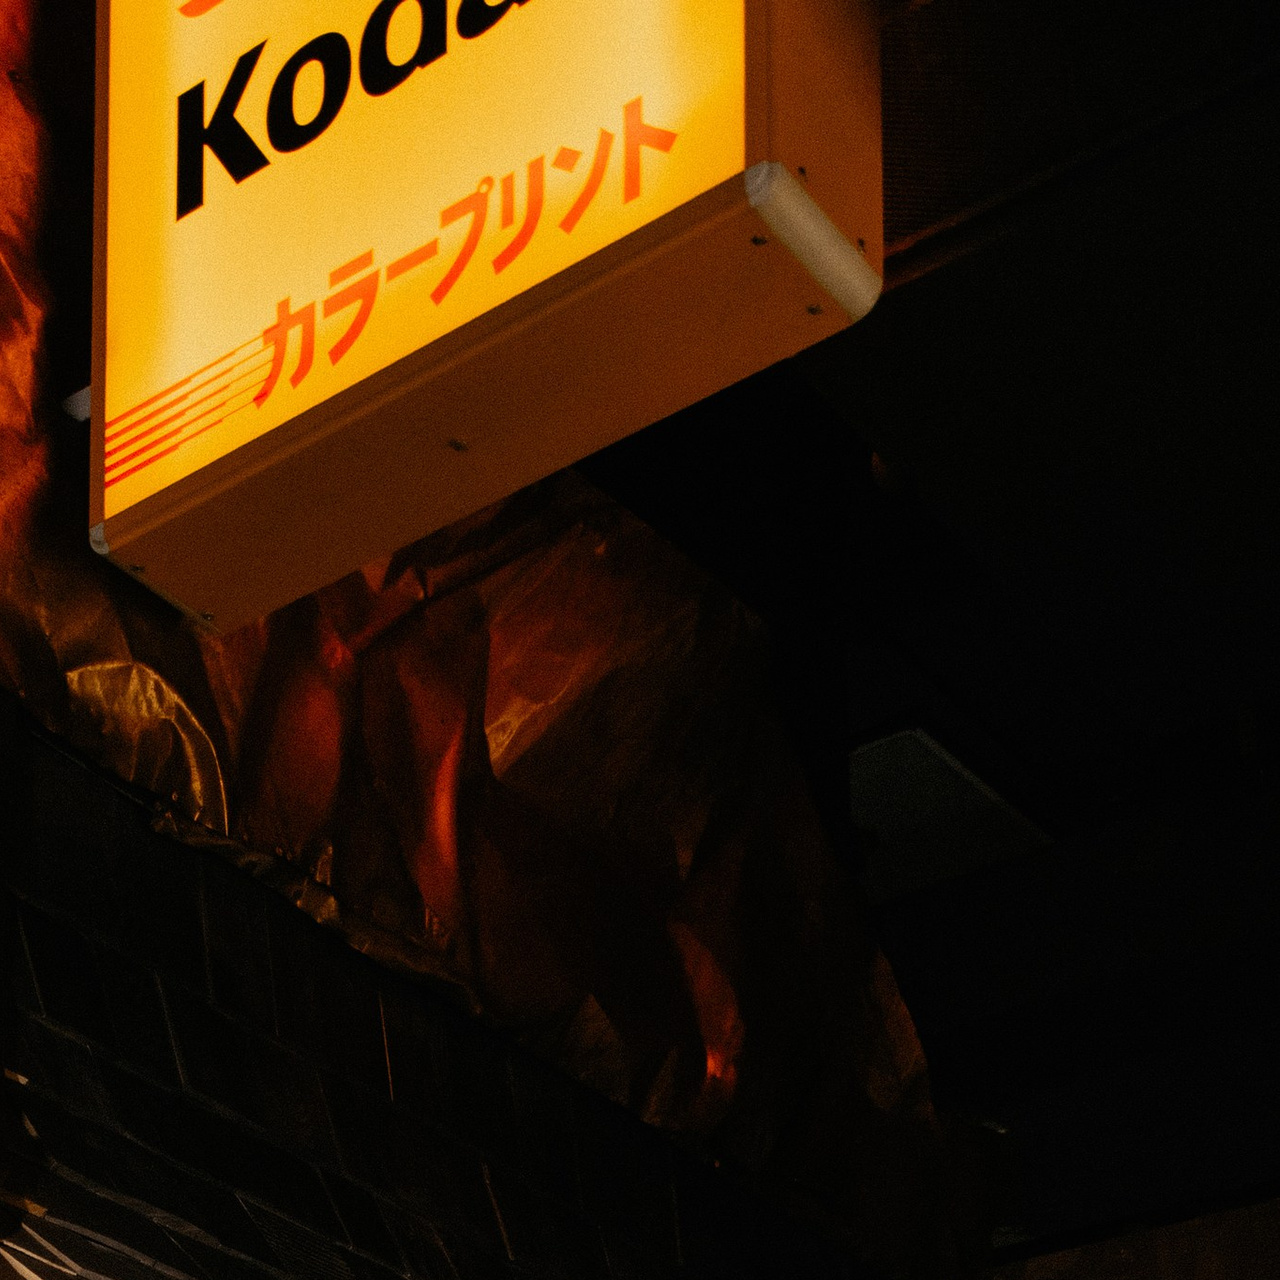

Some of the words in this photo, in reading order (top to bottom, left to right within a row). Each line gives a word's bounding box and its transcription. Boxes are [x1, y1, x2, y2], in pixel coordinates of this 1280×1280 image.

[253, 96, 678, 409] カラープリント
